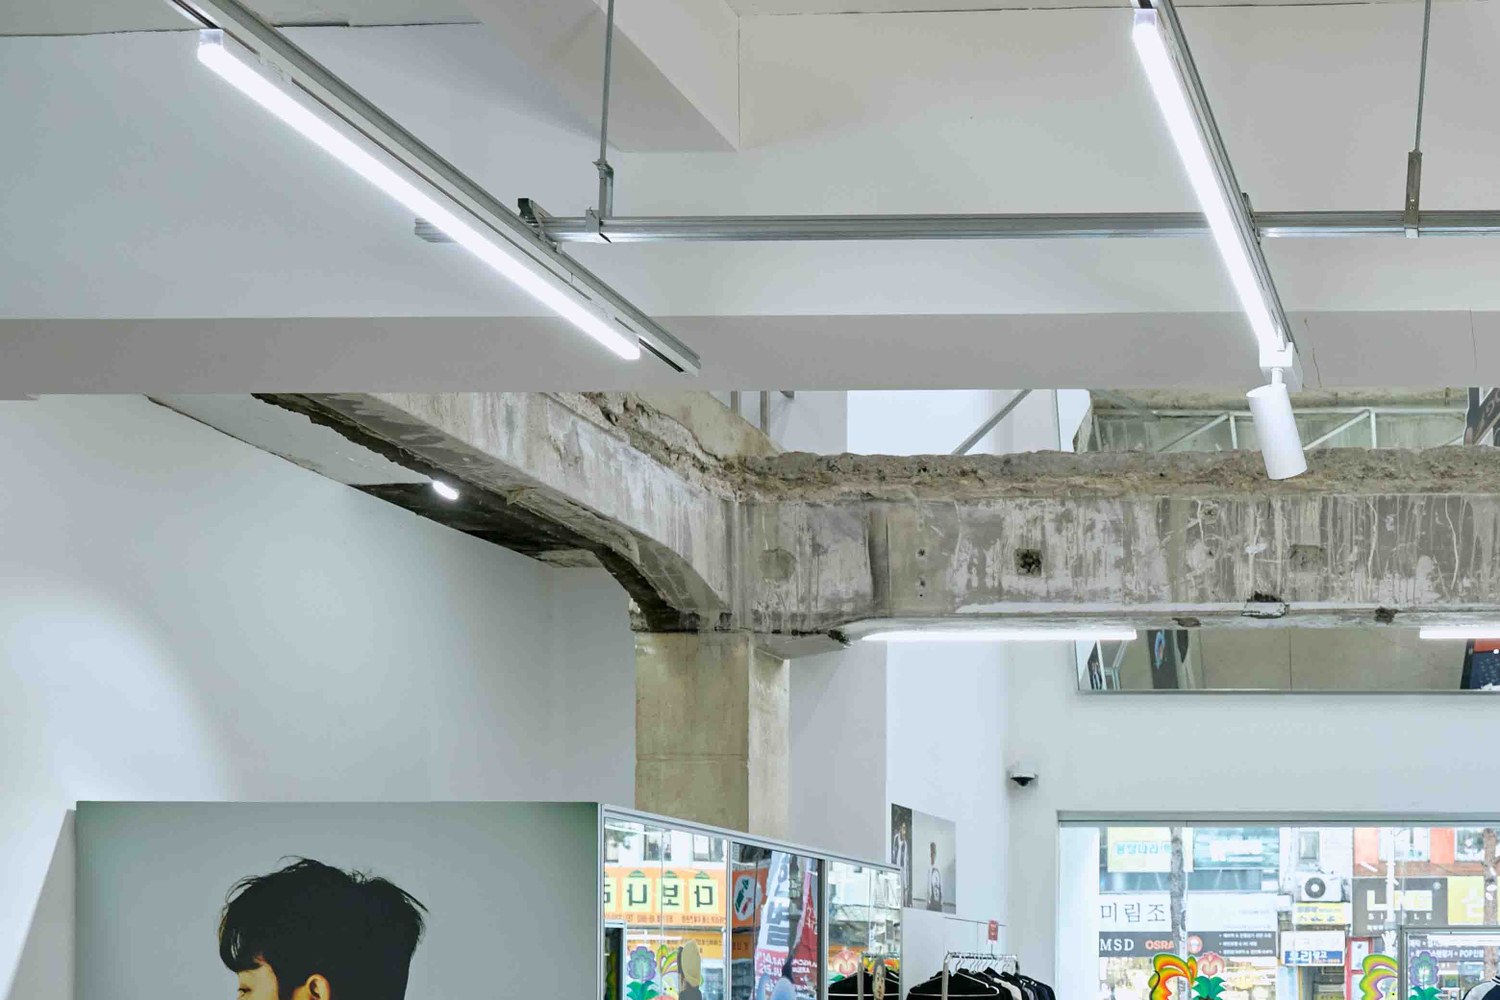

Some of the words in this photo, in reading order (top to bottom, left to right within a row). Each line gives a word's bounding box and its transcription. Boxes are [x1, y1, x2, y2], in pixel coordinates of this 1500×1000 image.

[1100, 902, 1167, 923] 미림조
[1100, 938, 1135, 951] MSD
[1145, 940, 1175, 950] OSRA
